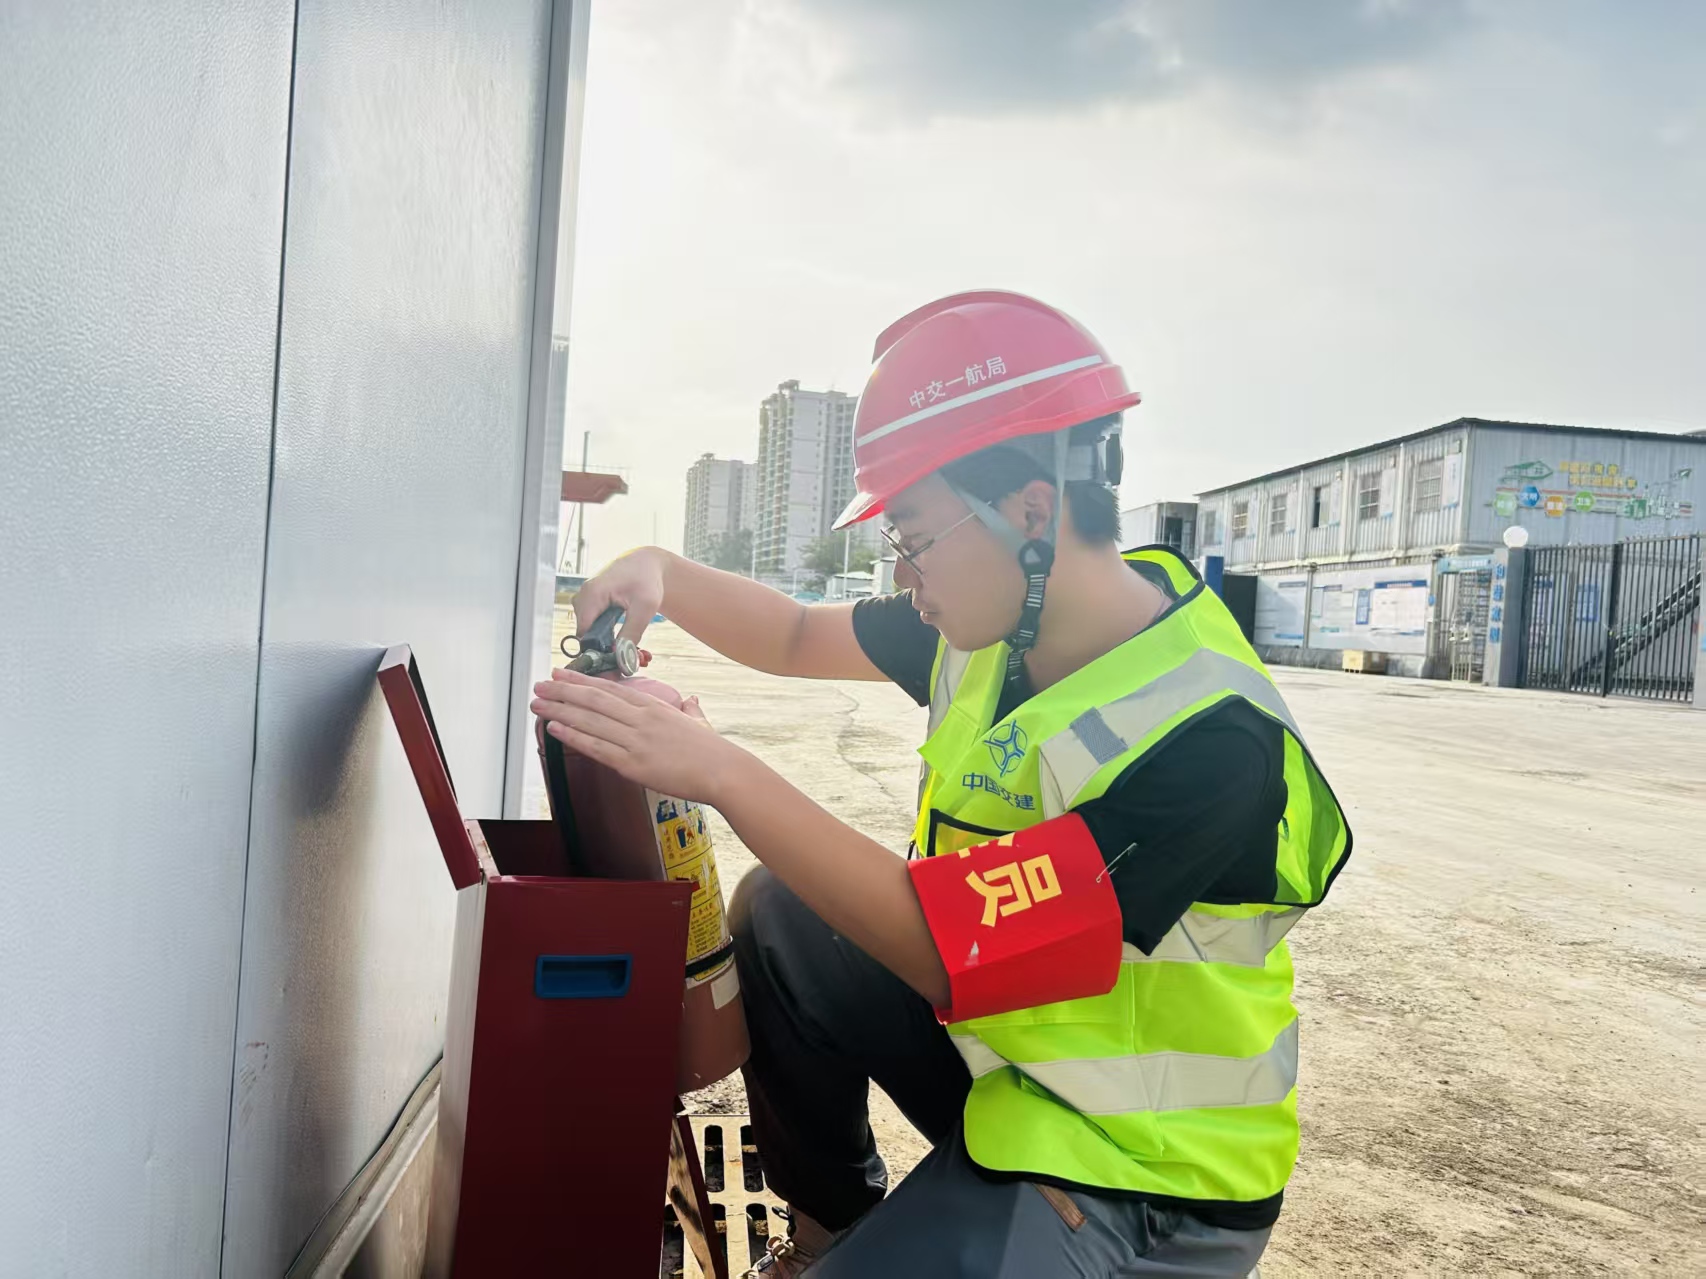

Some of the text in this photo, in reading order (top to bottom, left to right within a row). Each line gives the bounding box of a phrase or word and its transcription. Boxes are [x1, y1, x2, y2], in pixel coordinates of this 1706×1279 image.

[909, 356, 1007, 409] 中交一航局
[962, 772, 1036, 810] 中国交建
[956, 832, 1062, 928] 员
